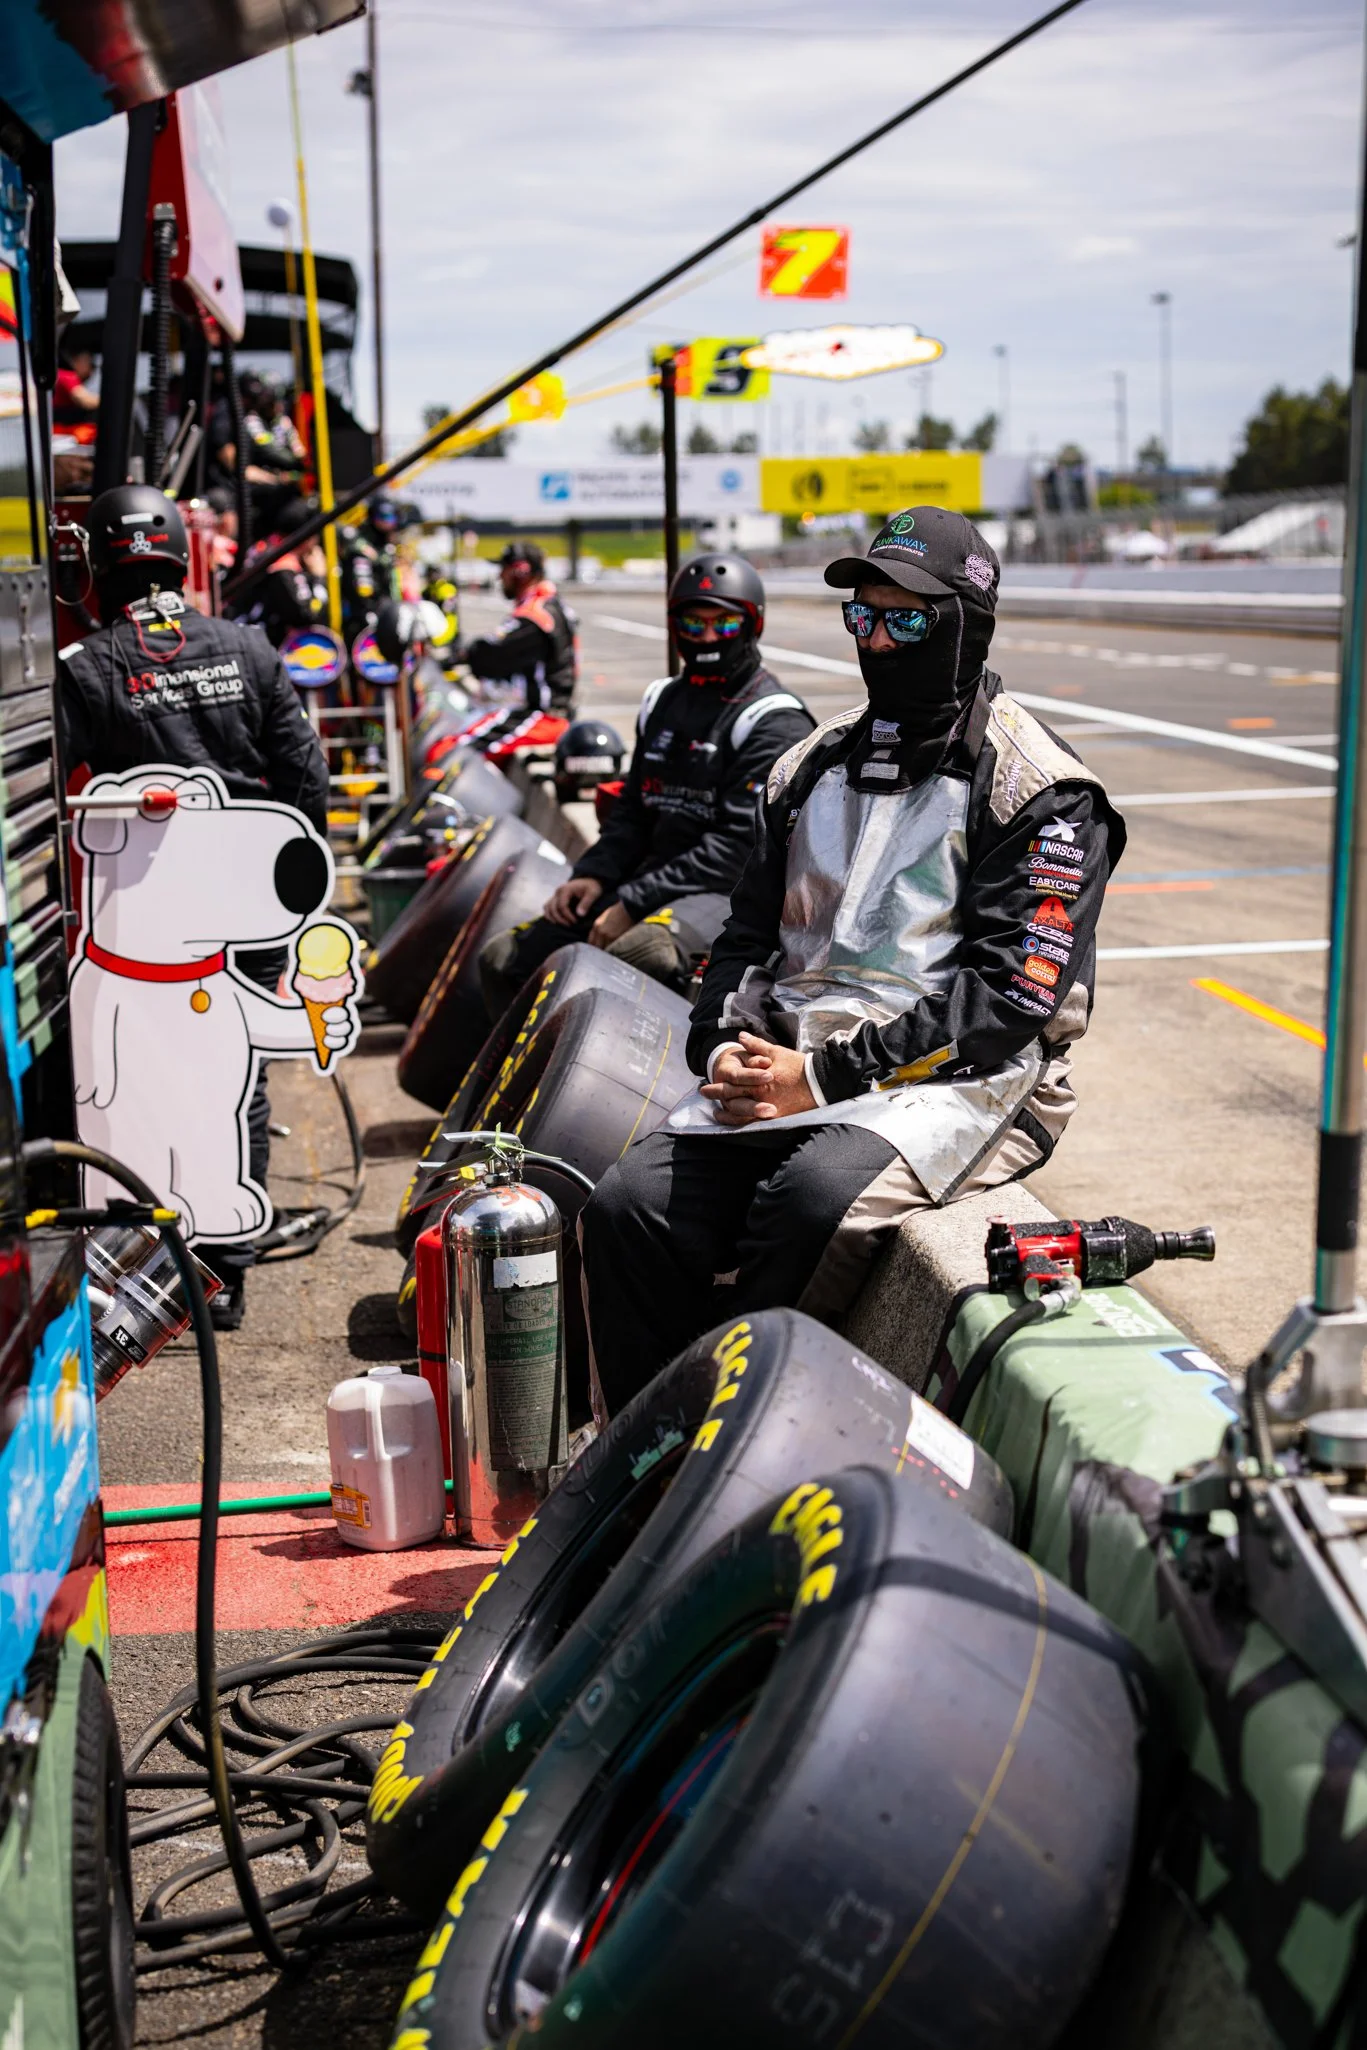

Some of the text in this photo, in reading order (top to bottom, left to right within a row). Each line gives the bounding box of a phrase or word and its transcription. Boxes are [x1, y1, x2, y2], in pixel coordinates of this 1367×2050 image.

[769, 229, 842, 296] 7
[196, 678, 244, 697] Group
[1044, 841, 1085, 863] NASCAR
[1029, 876, 1081, 892] EASYCARE
[1033, 915, 1074, 933] AXALTA
[1038, 942, 1070, 959] state
[1028, 959, 1056, 975] golden
[1031, 967, 1057, 982] corral
[1018, 996, 1052, 1016] IMPACT
